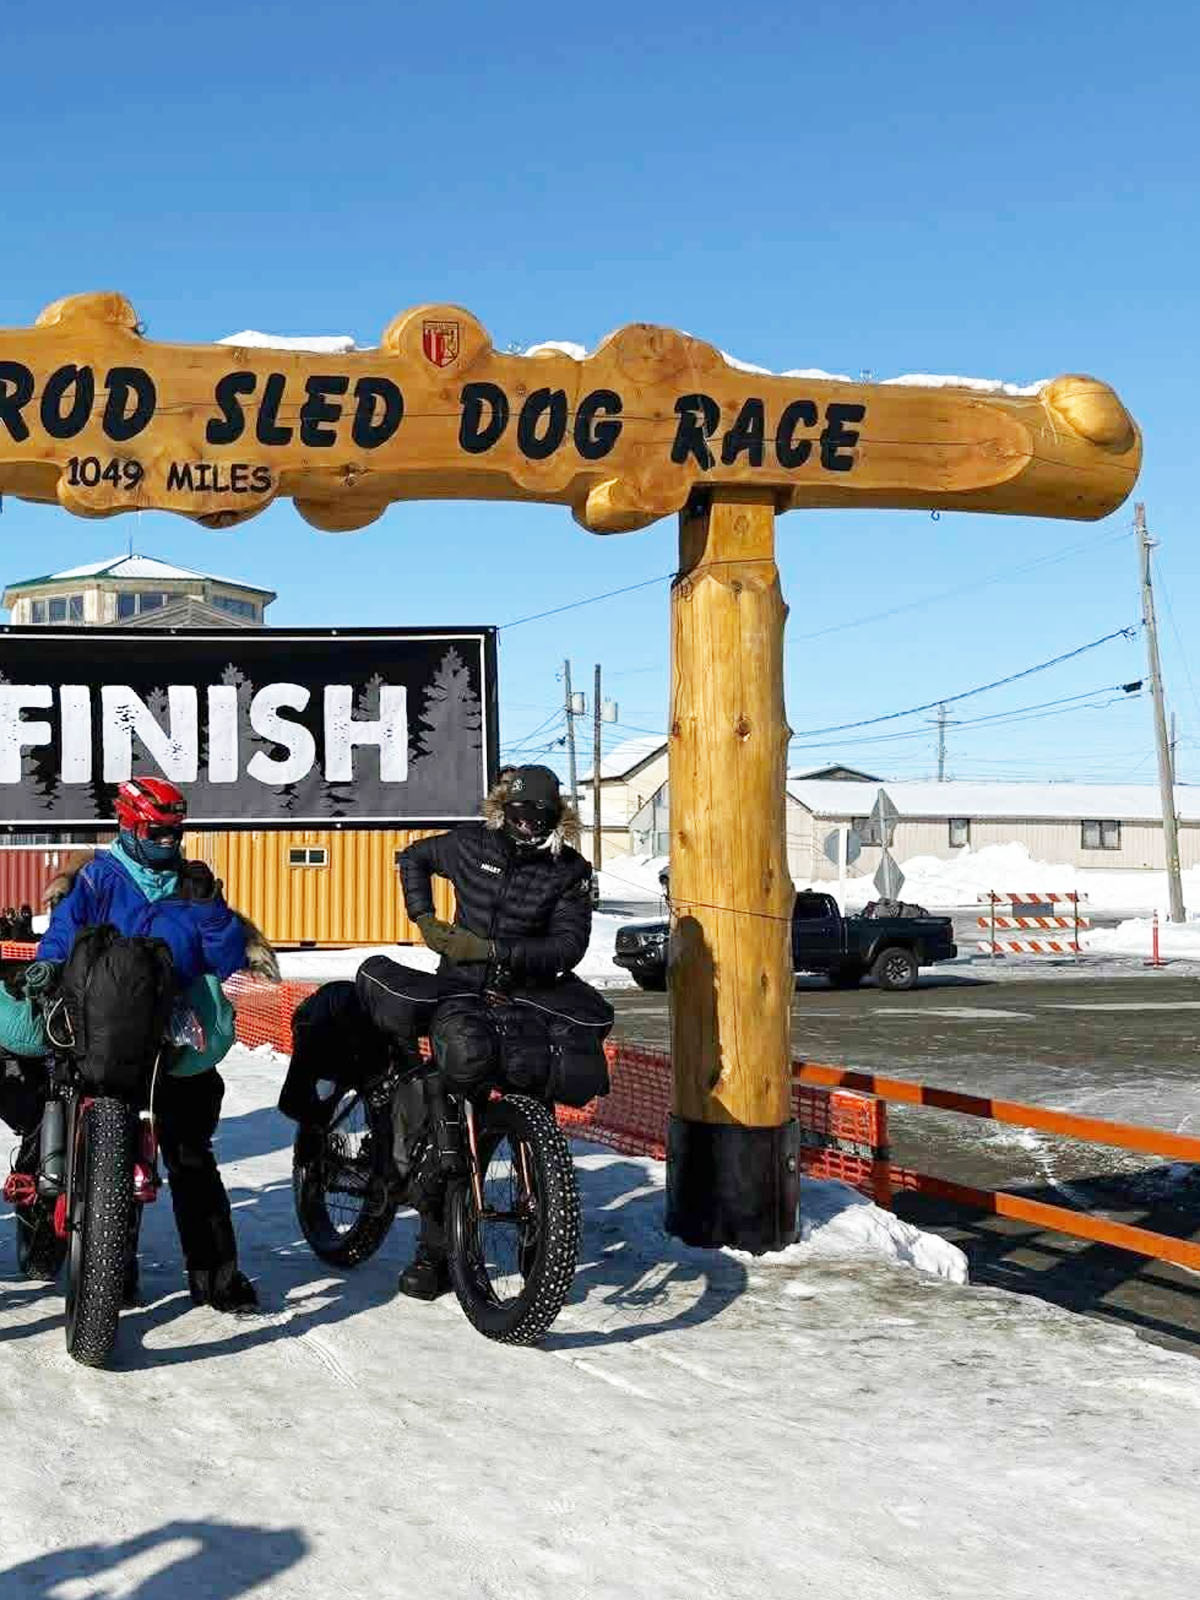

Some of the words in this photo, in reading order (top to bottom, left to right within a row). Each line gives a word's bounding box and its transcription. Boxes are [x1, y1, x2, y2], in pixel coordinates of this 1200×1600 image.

[207, 372, 403, 448] SLED
[459, 383, 622, 459] DOG
[671, 394, 865, 471] RACE
[68, 457, 144, 490] 1049
[167, 463, 271, 493] MILES
